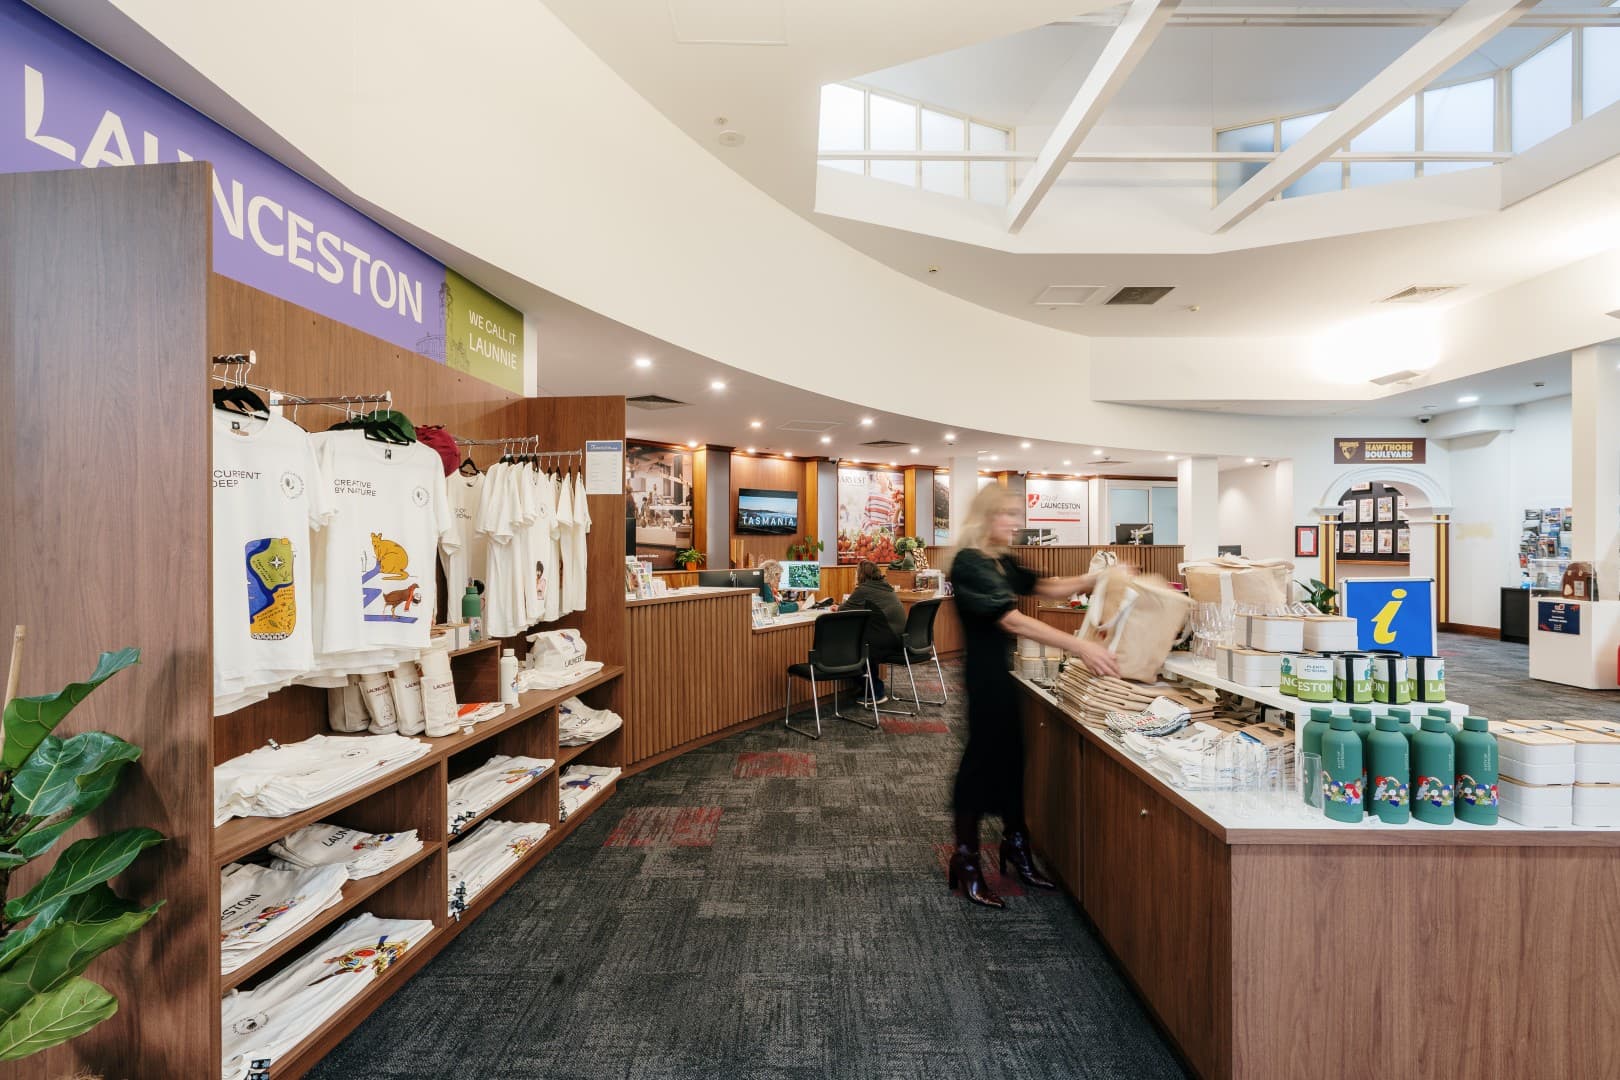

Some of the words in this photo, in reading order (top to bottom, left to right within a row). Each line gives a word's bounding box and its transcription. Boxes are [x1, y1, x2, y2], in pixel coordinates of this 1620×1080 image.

[469, 310, 484, 330] WE
[486, 320, 508, 342] CALL
[509, 332, 517, 345] IT
[469, 333, 517, 370] LAUNNIE
[1365, 443, 1413, 451] HAWTHORN
[334, 479, 372, 489] CREATIVE
[347, 487, 377, 497] NATURE
[1040, 502, 1081, 510] LAUNCESTON
[742, 516, 795, 526] TASMANIA
